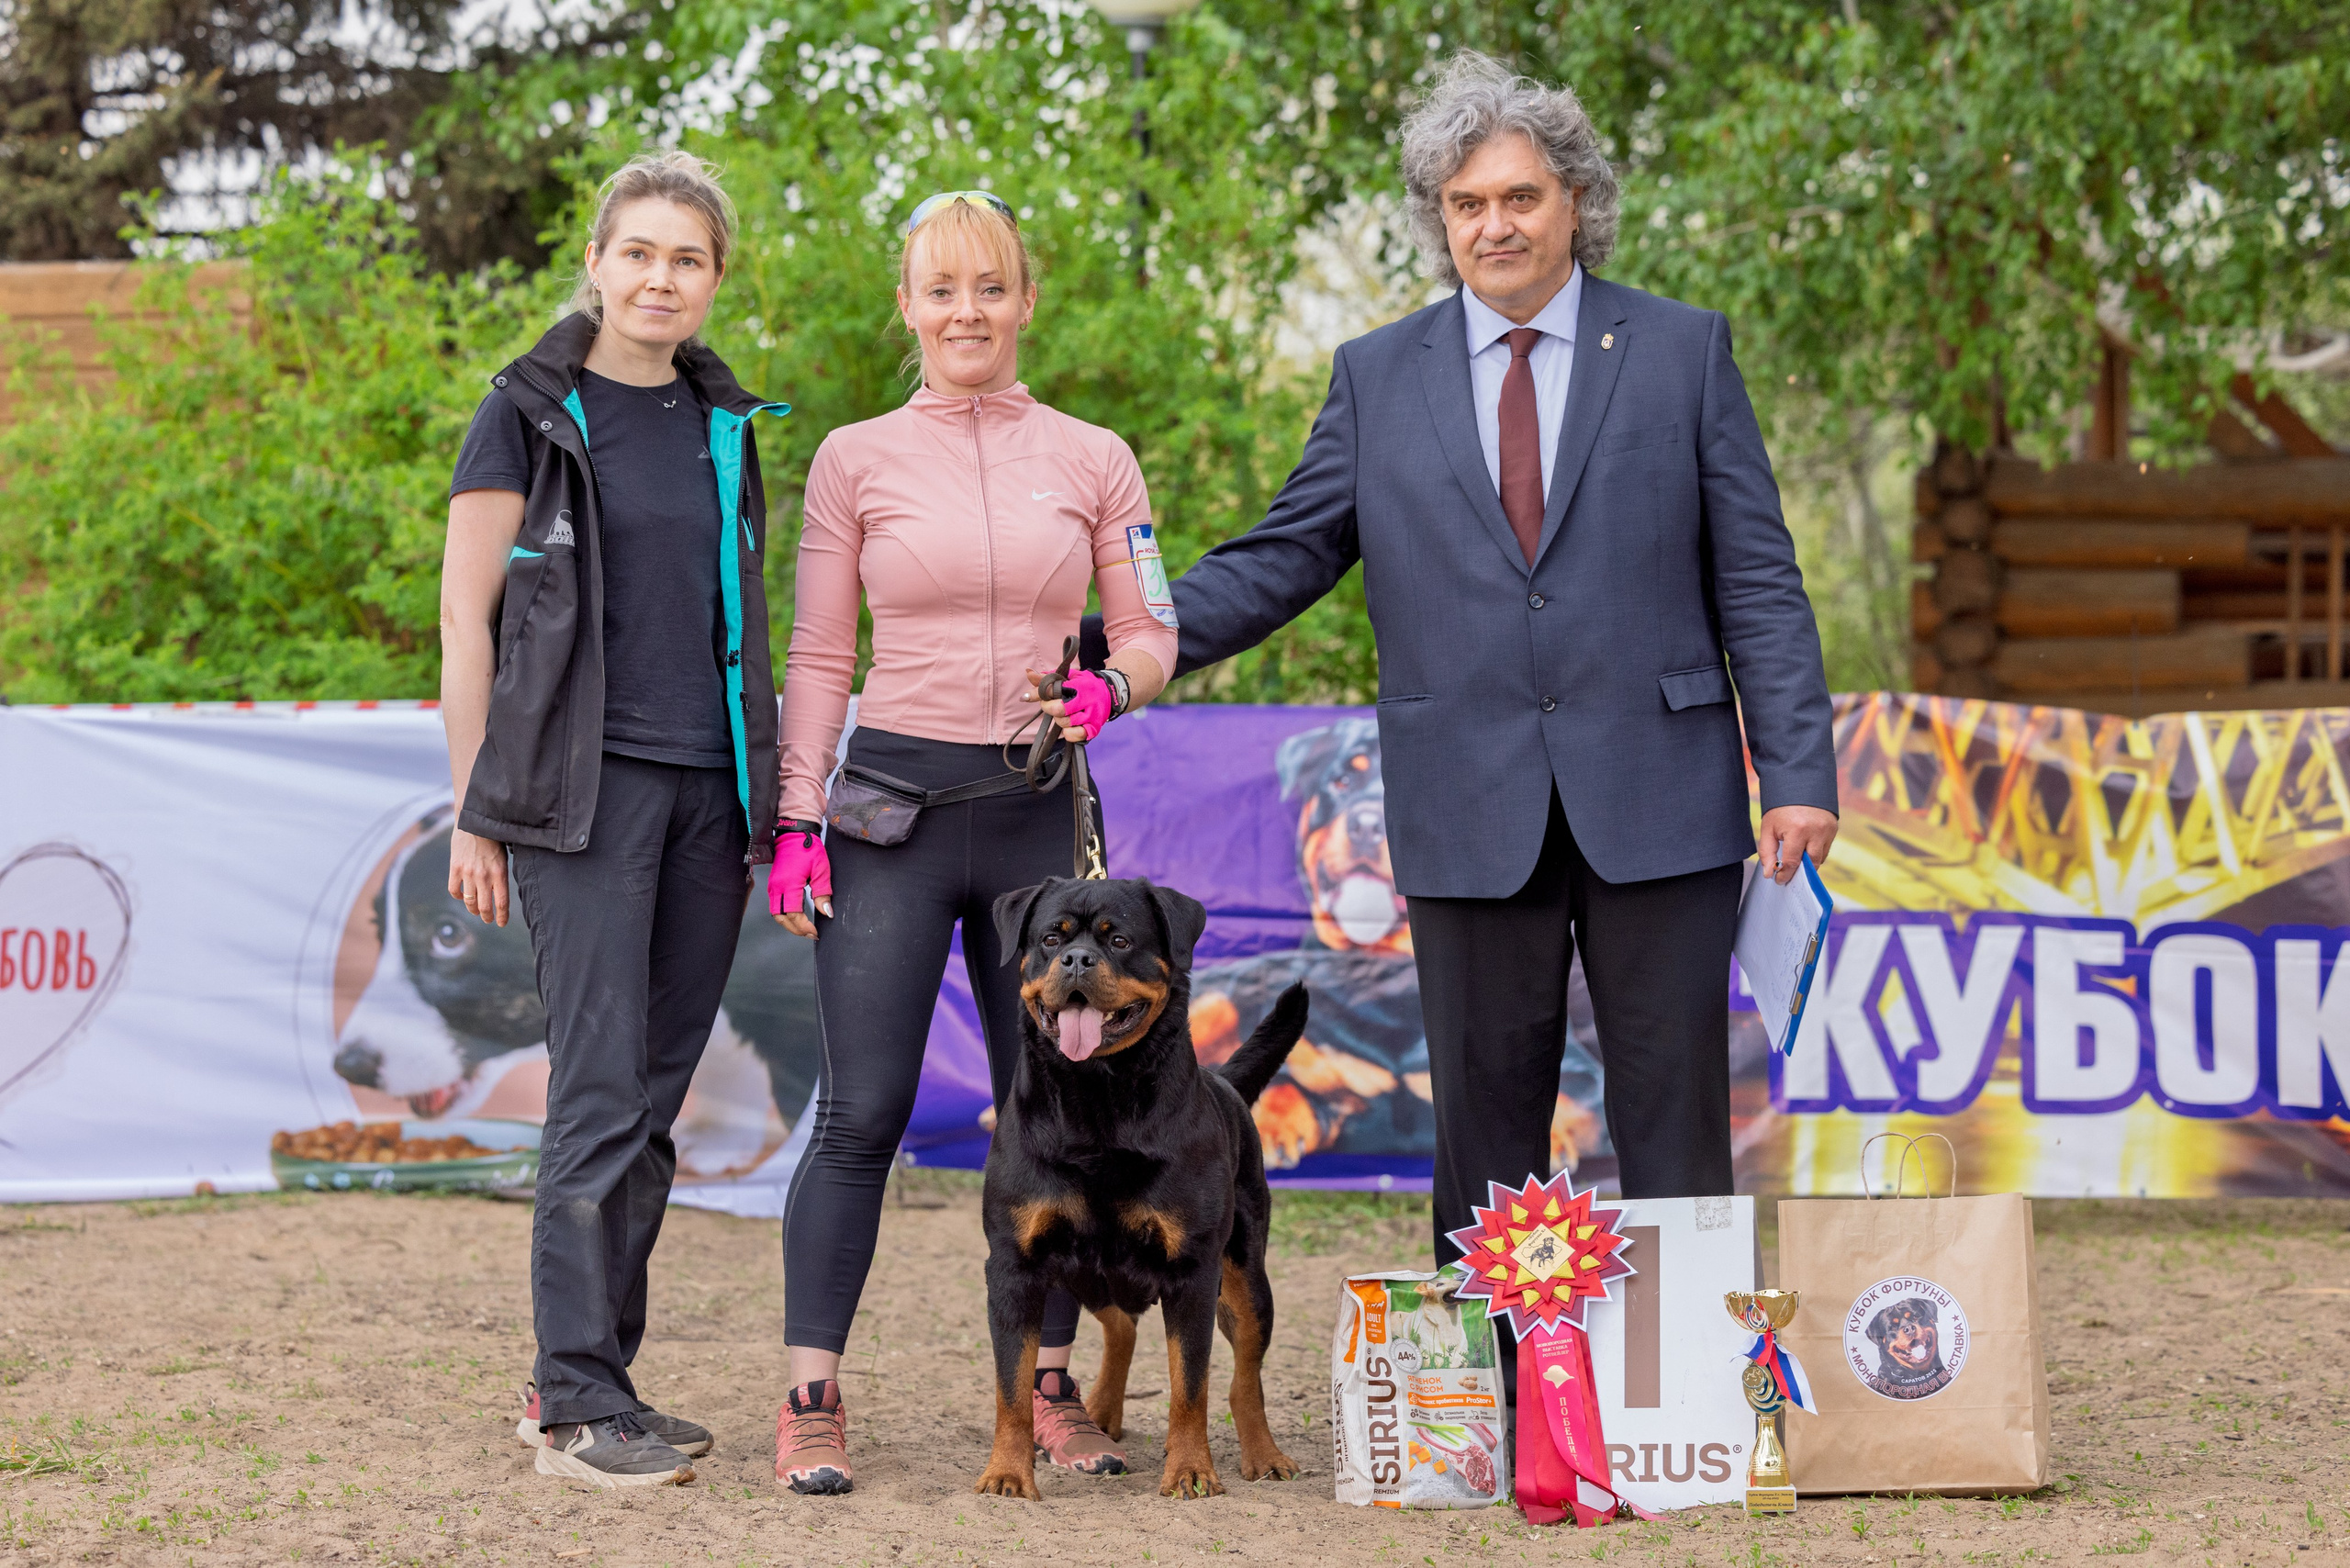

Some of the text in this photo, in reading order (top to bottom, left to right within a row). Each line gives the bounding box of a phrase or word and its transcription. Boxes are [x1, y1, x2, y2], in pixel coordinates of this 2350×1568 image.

[1784, 924, 2350, 1108] КУБОК
[1367, 1312, 1382, 1323] ADULT
[1848, 1280, 1952, 1333] КУБОК ФОРТУНЫ
[1397, 1351, 1416, 1361] 44%
[1852, 1322, 1964, 1398] МОНОПОРОДНАЯ ВЫСТАВКА
[1407, 1374, 1442, 1384] ЯГНЕНОК
[1415, 1384, 1444, 1394] РИСОМ
[1900, 1375, 1926, 1383] САРАТОВ
[1366, 1356, 1402, 1485] SIRIUS
[1606, 1442, 1732, 1484] RIUS
